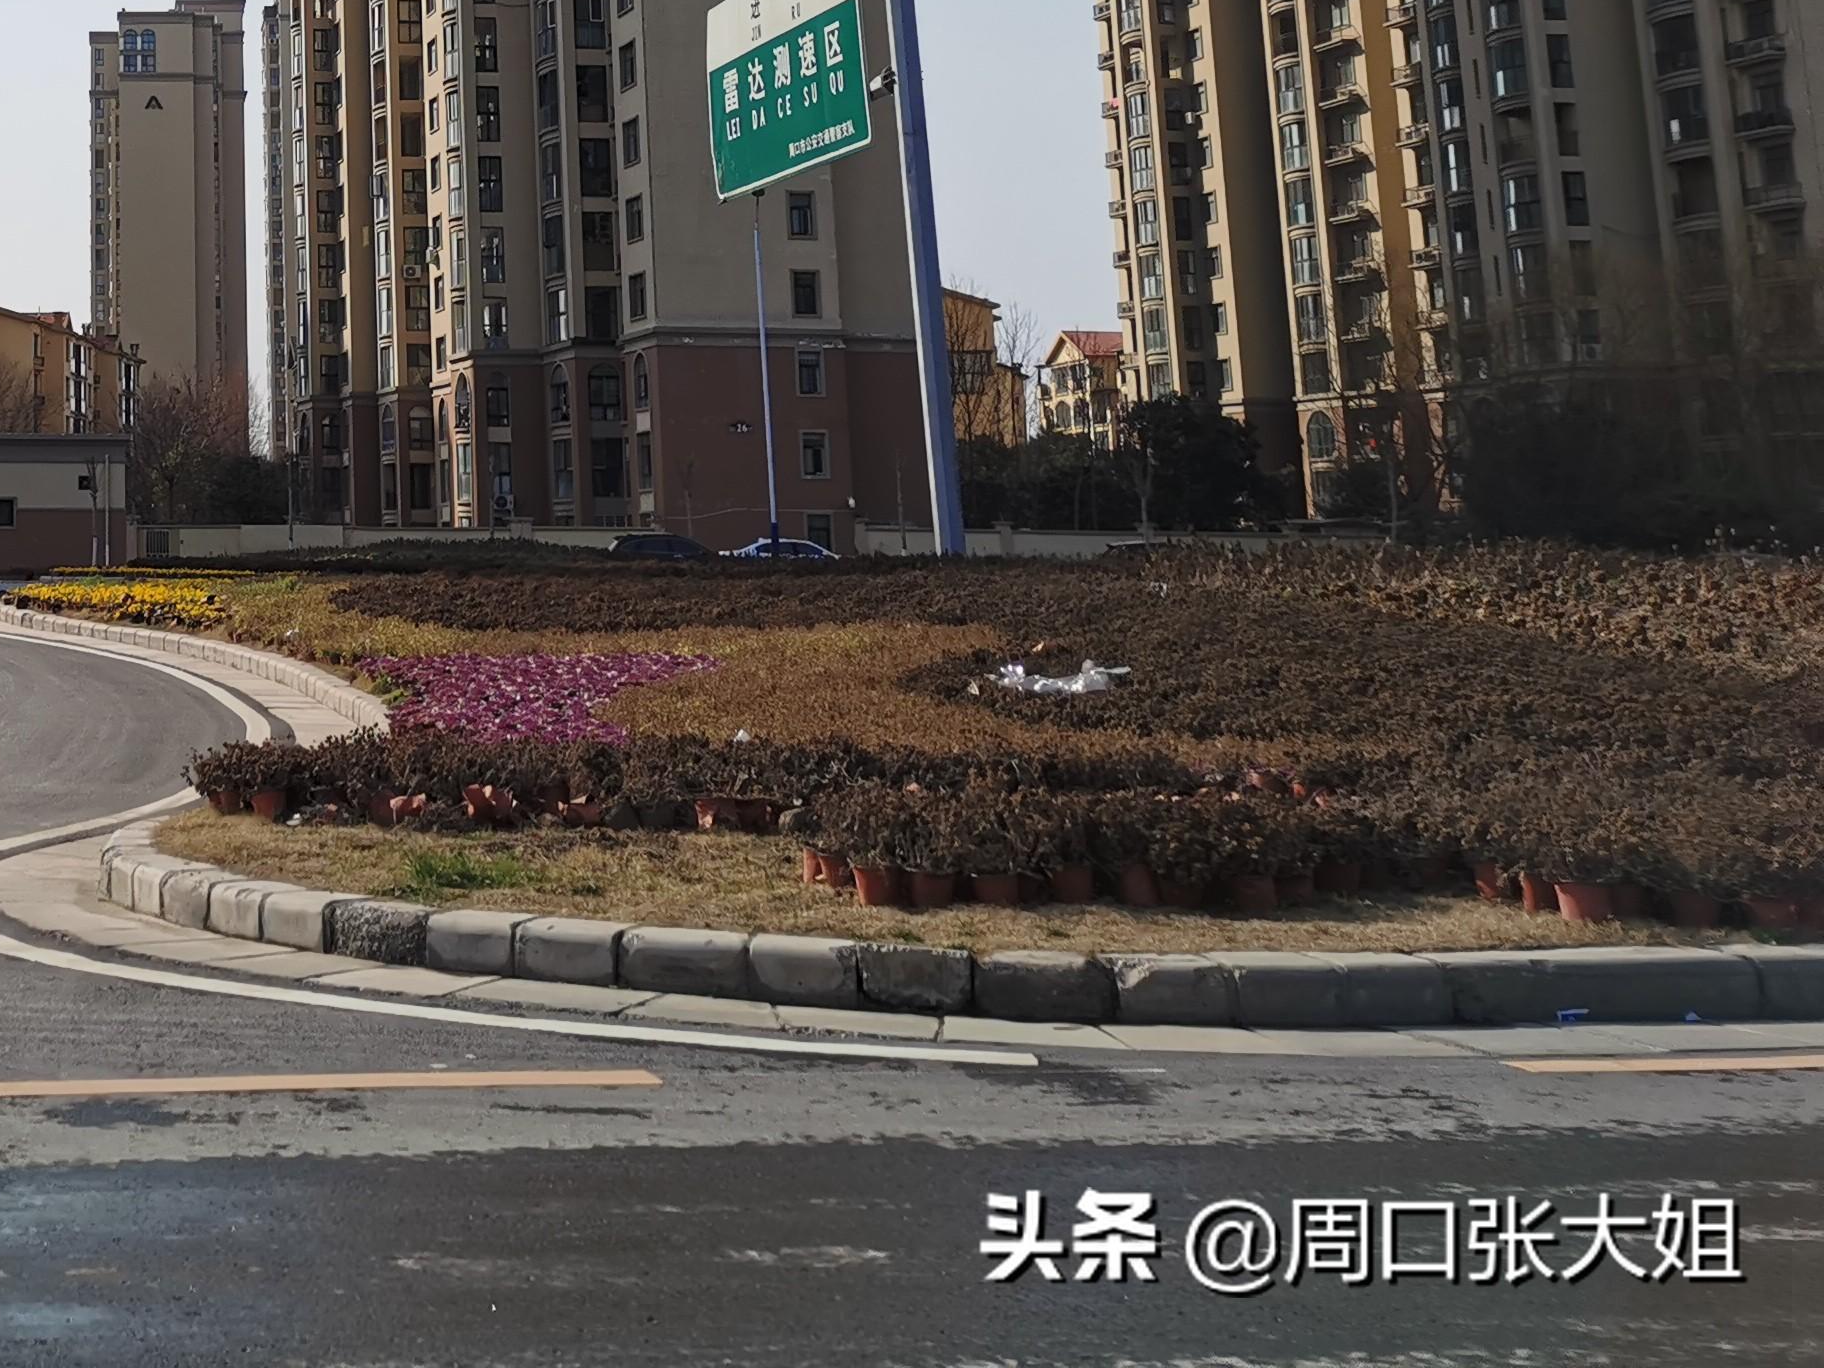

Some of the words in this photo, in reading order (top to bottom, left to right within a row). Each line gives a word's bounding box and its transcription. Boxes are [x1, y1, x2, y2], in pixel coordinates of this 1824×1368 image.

[751, 23, 761, 42] JIN
[791, 2, 801, 20] RU
[723, 21, 844, 114] 雷达测速区
[726, 117, 741, 142] LEI
[751, 106, 766, 131] DA
[777, 94, 792, 119] CE
[802, 82, 818, 108] SU
[829, 70, 844, 96] QU
